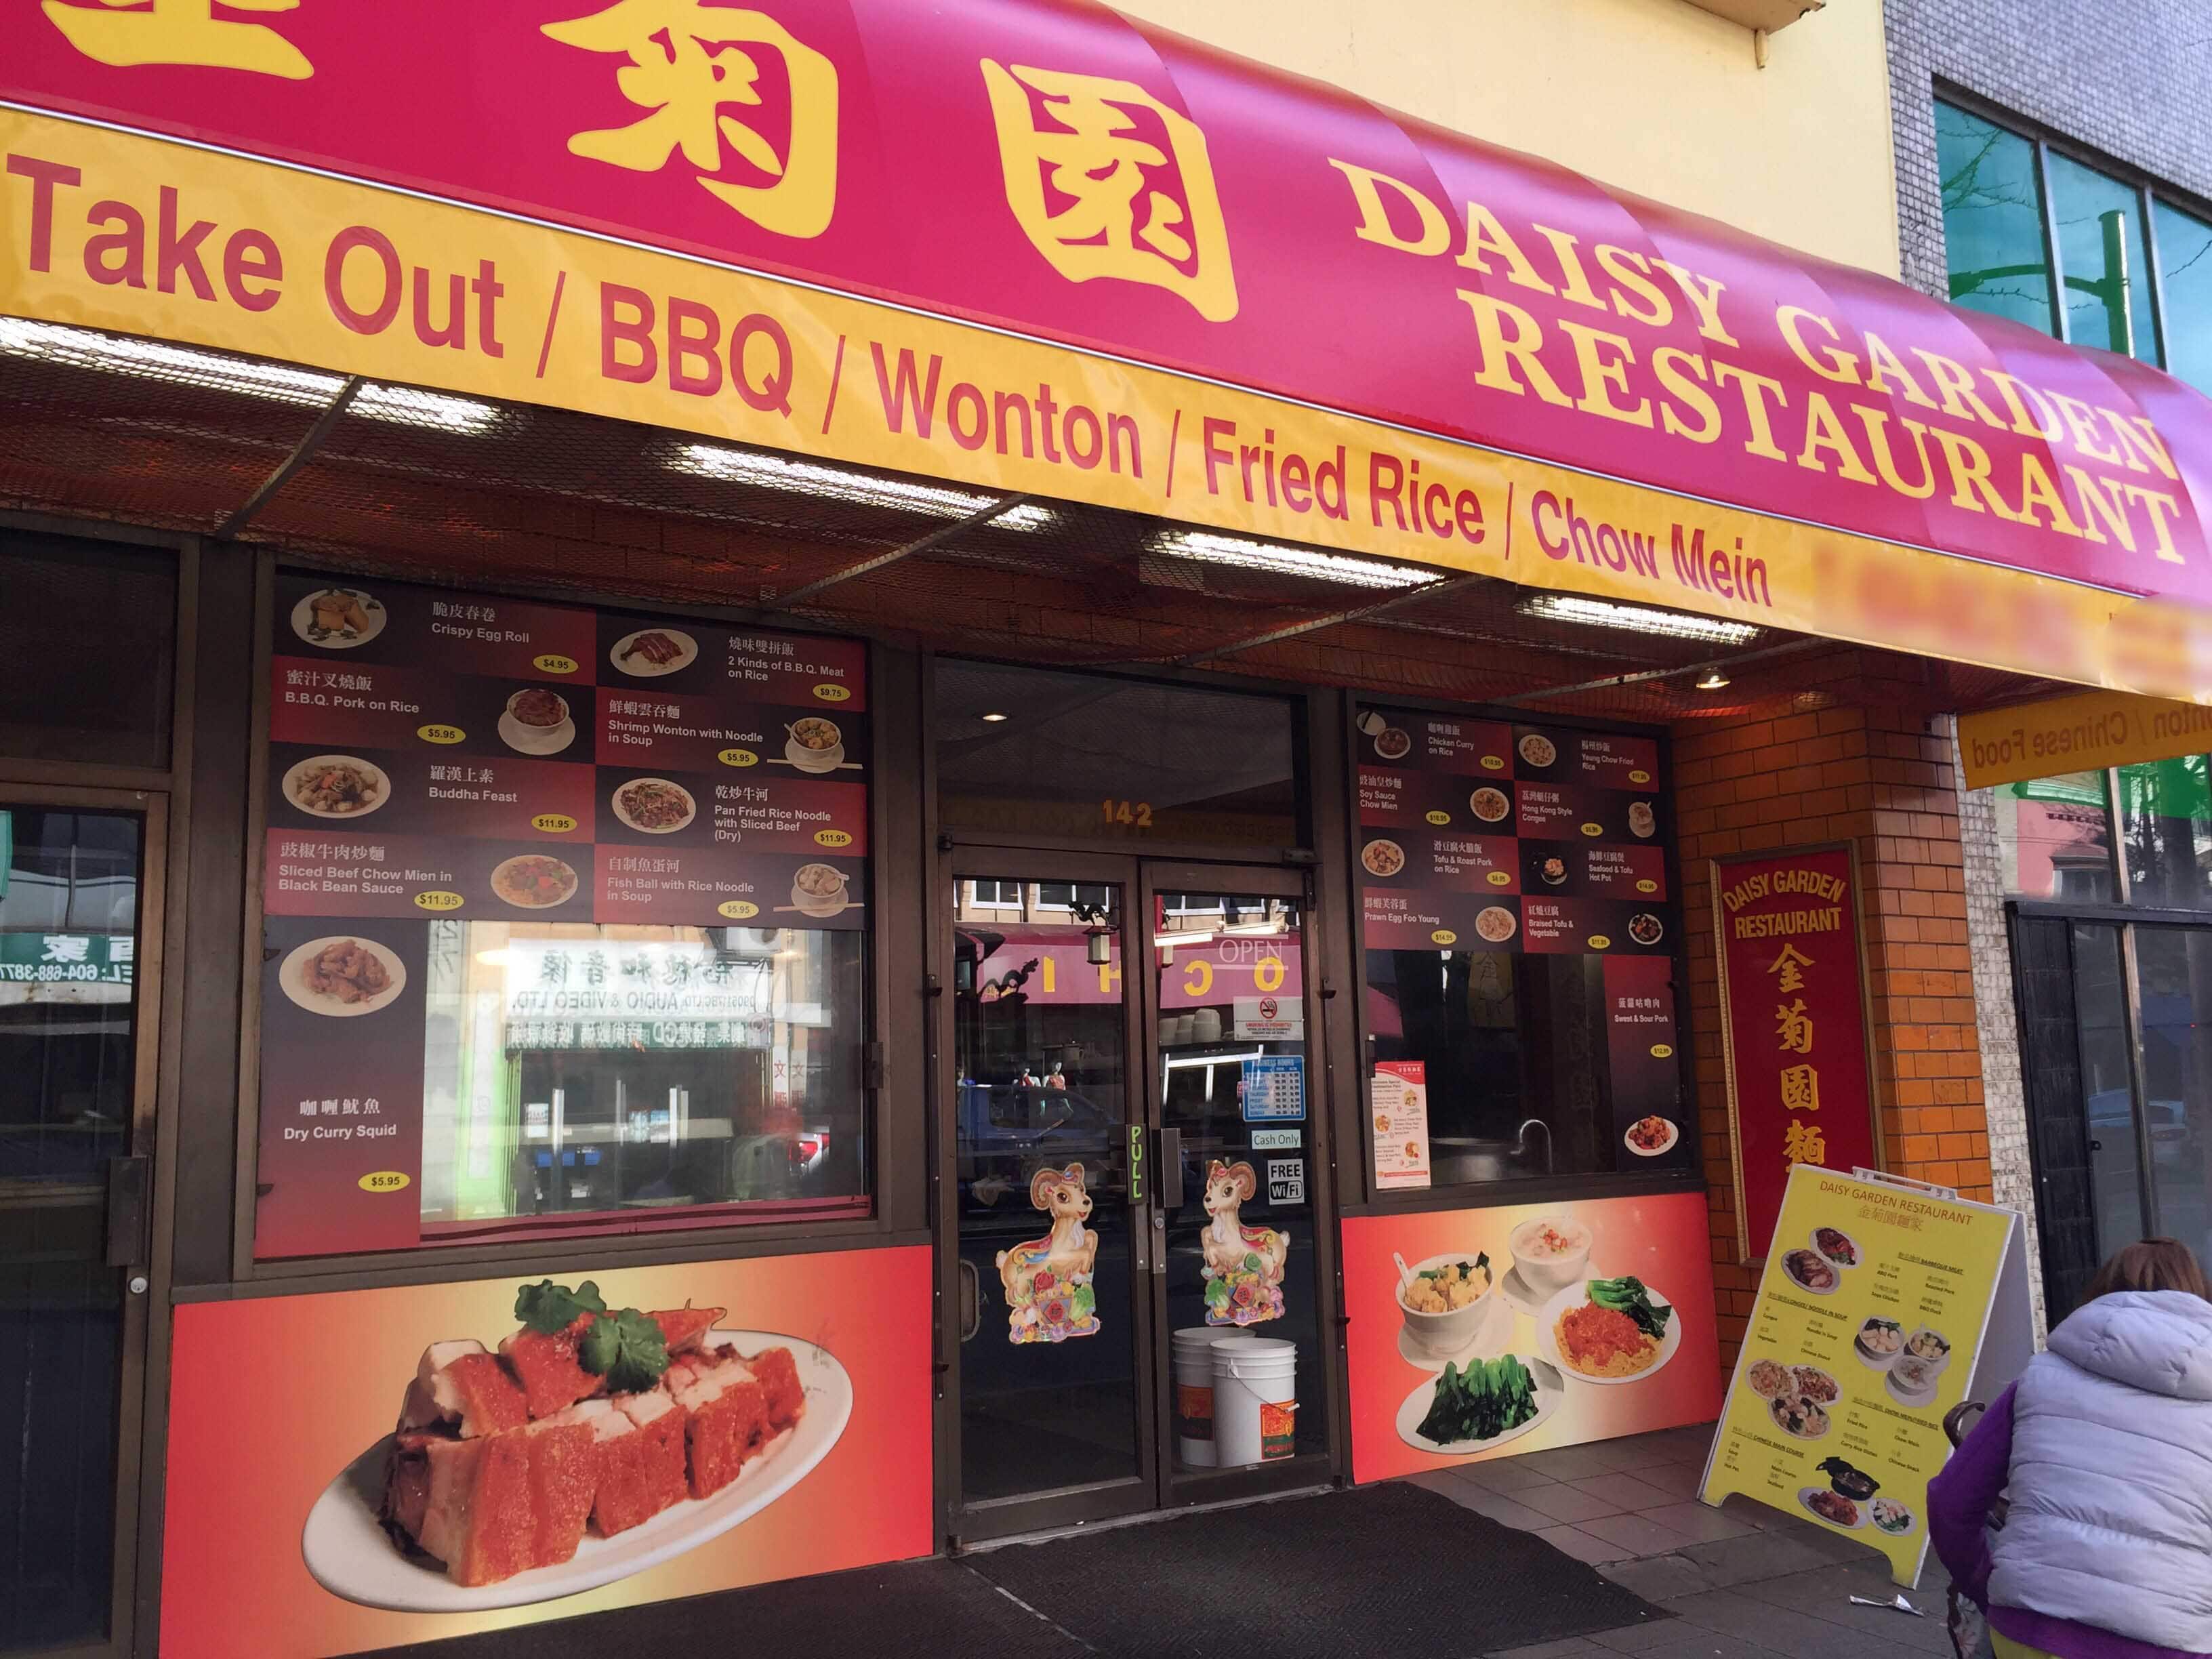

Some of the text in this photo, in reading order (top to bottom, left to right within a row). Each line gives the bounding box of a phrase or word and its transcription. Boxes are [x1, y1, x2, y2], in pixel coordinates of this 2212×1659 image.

[1328, 157, 2180, 480] DAISY GARDEN
[7, 153, 283, 312] Take
[324, 225, 504, 359] Out
[601, 281, 793, 418] BBQ
[870, 342, 1143, 478] Wonton
[1203, 416, 1349, 520] Fried
[1369, 451, 1486, 544] Rice
[1532, 489, 1657, 579] Chow
[1671, 523, 1771, 608] Mein
[1456, 289, 2185, 565] RESTAURANT
[431, 621, 529, 643] Crispy Egg Roll
[543, 658, 569, 670] $4.95
[728, 656, 844, 677] 2 Kinds of B.B.Q. Meat
[728, 670, 769, 681] on Rice
[820, 688, 842, 697] $9.75
[285, 692, 419, 714] B.B.Q. Pork on Rice
[428, 728, 455, 739] $5.95
[609, 720, 763, 743] Shrimp Wonton with Noodle
[609, 733, 652, 747] in Soup
[1456, 740, 1474, 750] Curry
[727, 752, 750, 762] $5.95
[1439, 747, 1454, 756] Rice
[428, 786, 518, 803] Buddha Feast
[1359, 790, 1395, 800] Soy Sauce
[1360, 800, 1380, 808] Chow
[1522, 804, 1572, 817] Hong Kong Style
[715, 805, 831, 821] Pan Fried Rice Noodle
[1103, 800, 1152, 827] 142
[538, 817, 569, 829] $11.95
[715, 818, 800, 832] with Sliced Beef
[714, 830, 741, 843] (Dry)
[820, 834, 846, 843] $11.95
[1434, 855, 1449, 863] Tofu
[1457, 857, 1476, 865] Roast
[1477, 858, 1492, 866] Pork
[279, 865, 452, 882] Sliced Beef Chow Mien in
[1445, 865, 1459, 874] Rice
[279, 879, 403, 895] Black Bean Sauce
[608, 877, 754, 893] Fish Ball with Rice Noodle
[1723, 870, 1846, 912] DAISY GARDEN
[419, 894, 457, 906] $11.95
[607, 891, 652, 903] in Soup
[727, 905, 750, 914] $5.95
[1365, 912, 1439, 925] Prawn Egg Foo Young
[1735, 907, 1841, 939] RESTAURANT
[1218, 939, 1283, 964] OPEN
[284, 1124, 396, 1141] Dry Curry Squid
[1254, 1134, 1299, 1147] Cash Only
[1131, 1126, 1142, 1198] PULL
[1271, 1164, 1300, 1178] FREE
[371, 1176, 400, 1187] $5.95
[1820, 1181, 1973, 1225] DAISY GARDEN RESTAURANT
